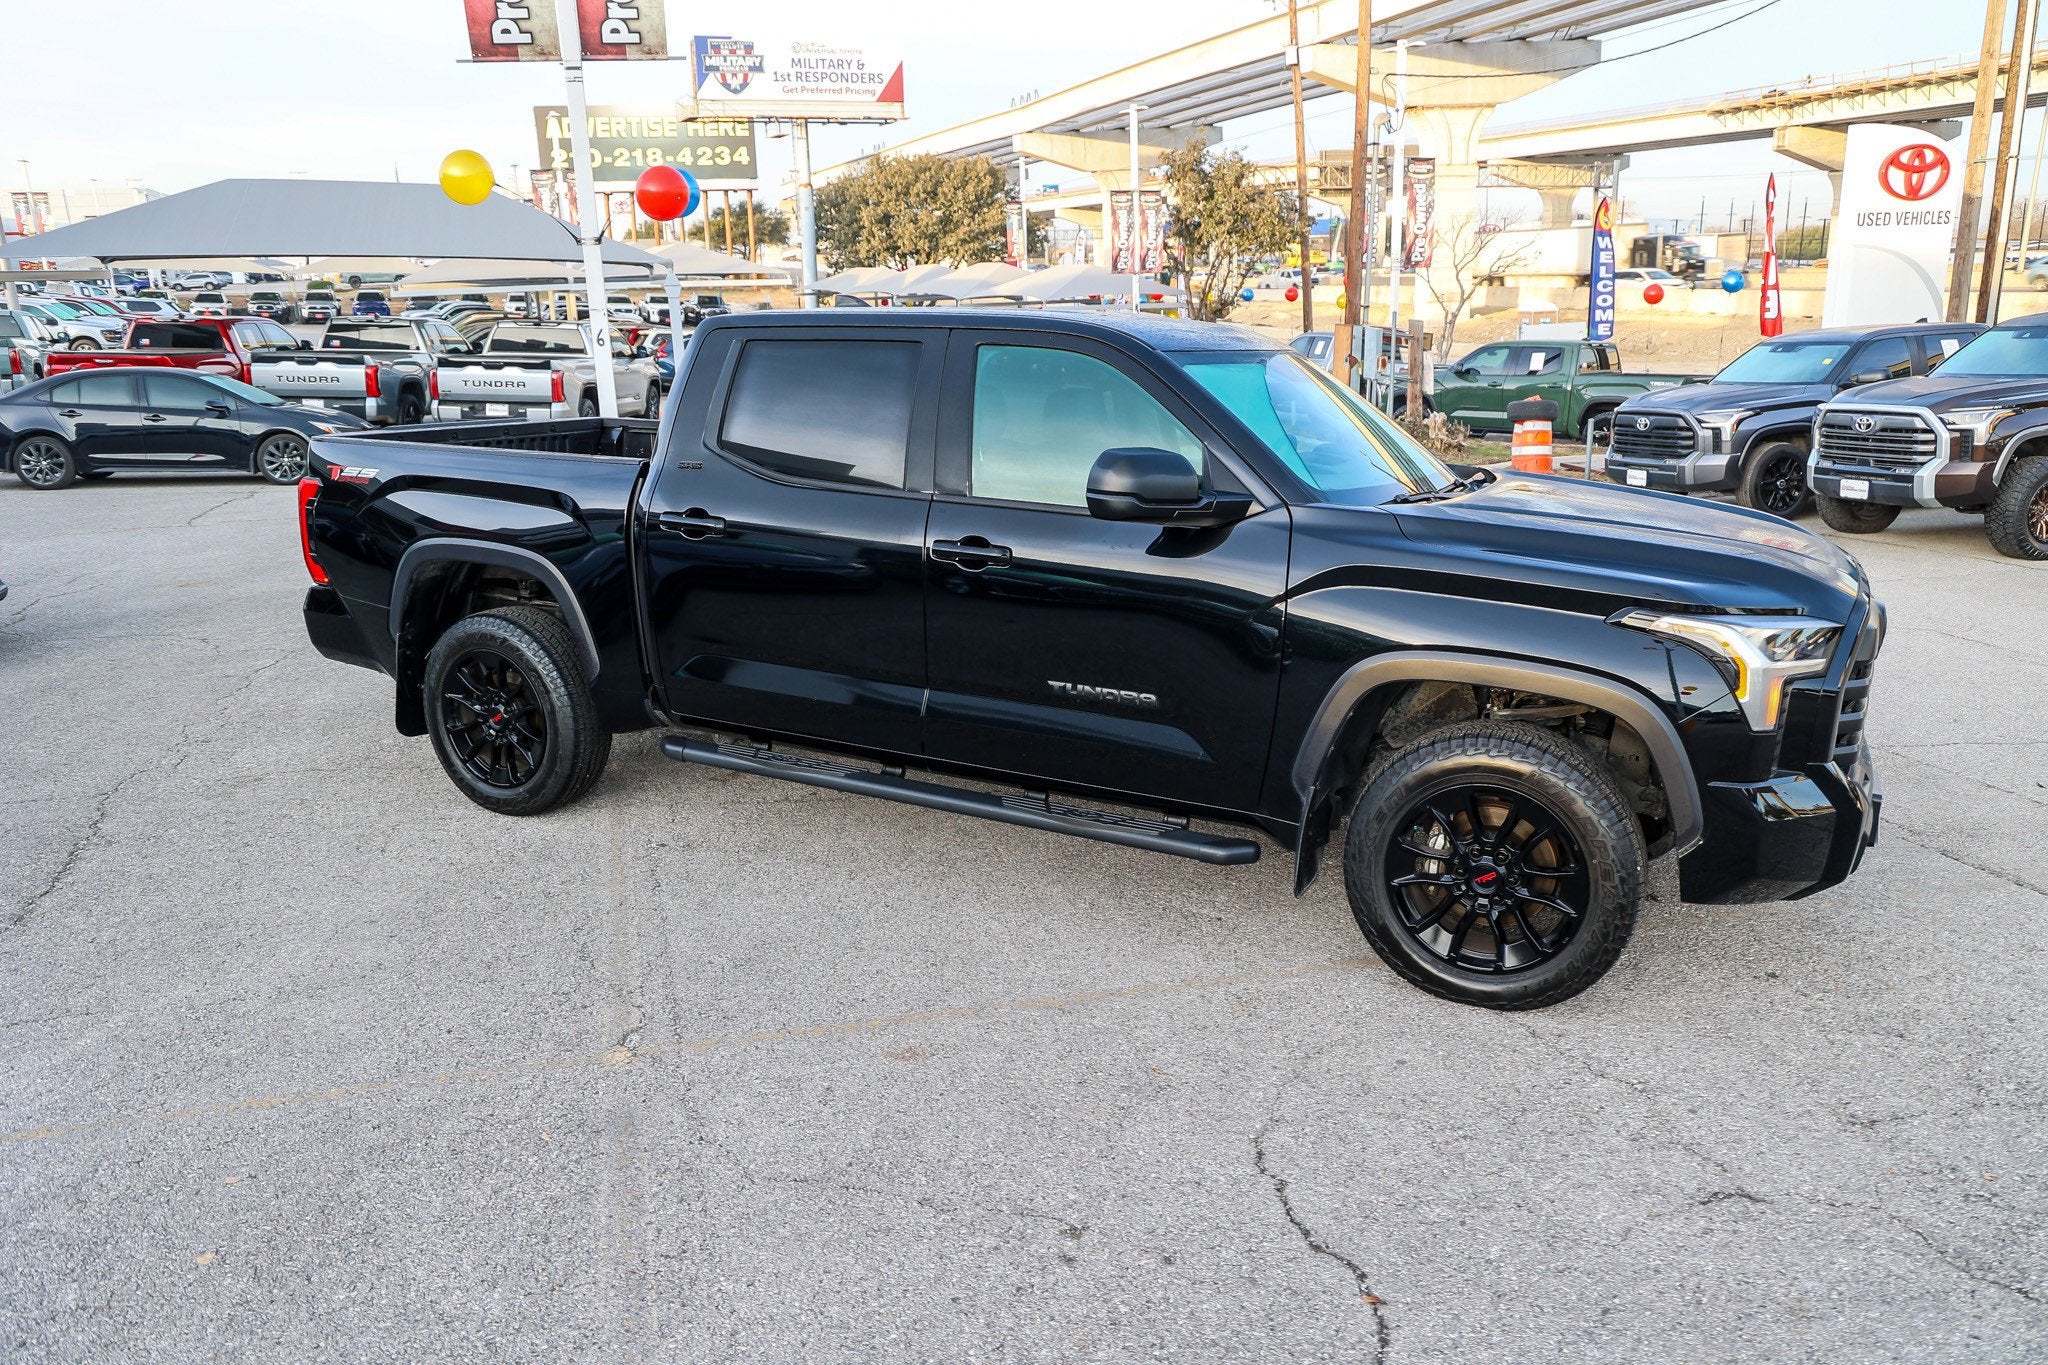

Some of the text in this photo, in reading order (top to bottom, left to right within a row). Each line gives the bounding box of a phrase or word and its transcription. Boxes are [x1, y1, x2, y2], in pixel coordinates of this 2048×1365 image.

[491, 0, 533, 45] Pr
[601, 0, 642, 45] Pr
[704, 55, 762, 67] MILITARY
[791, 57, 866, 70] MILITARY &
[773, 71, 884, 84] 1st RESPONDERS
[782, 85, 876, 97] Get Preferred Pricing
[687, 117, 750, 137] HERE
[1857, 210, 1951, 227] USED VEHICLES
[1595, 236, 1613, 336] WELCOME
[596, 328, 605, 347] 6
[275, 375, 340, 384] TUNDRA
[461, 379, 526, 389] TUNDRA
[326, 464, 381, 481] TSS
[1046, 680, 1158, 708] TUNDRA
